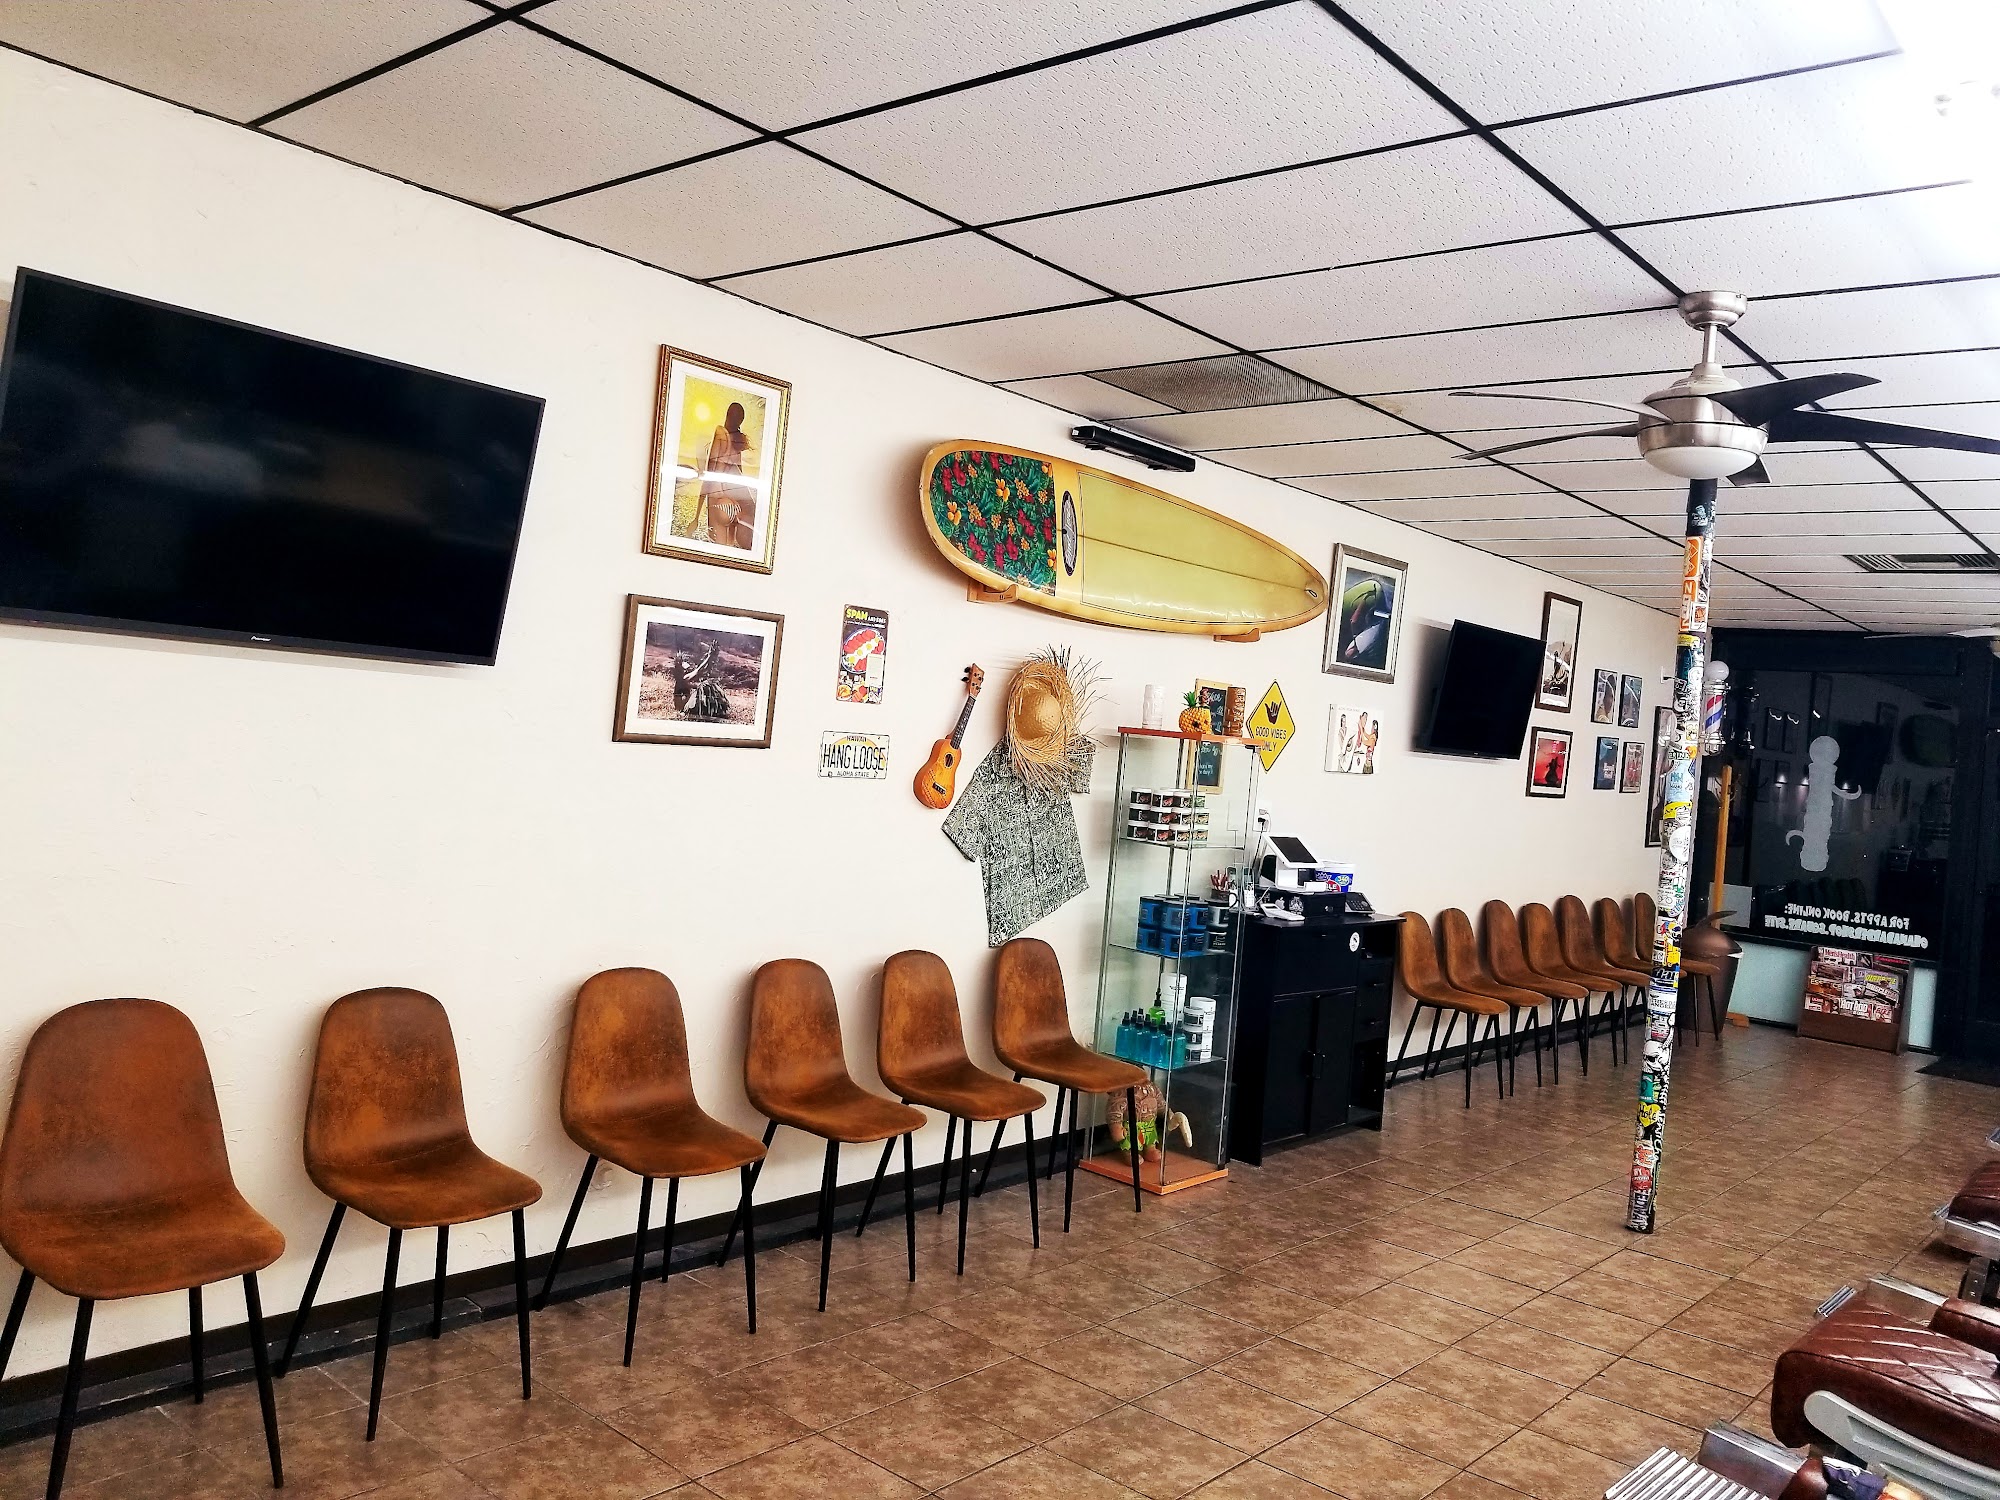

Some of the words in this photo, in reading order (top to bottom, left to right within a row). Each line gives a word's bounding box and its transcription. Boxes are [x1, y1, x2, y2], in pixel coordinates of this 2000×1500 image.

[846, 608, 868, 621] SPAM
[1255, 726, 1269, 737] GOOD
[1271, 728, 1287, 740] VIBES
[822, 744, 852, 769] HANG
[853, 745, 886, 770] LOOSE
